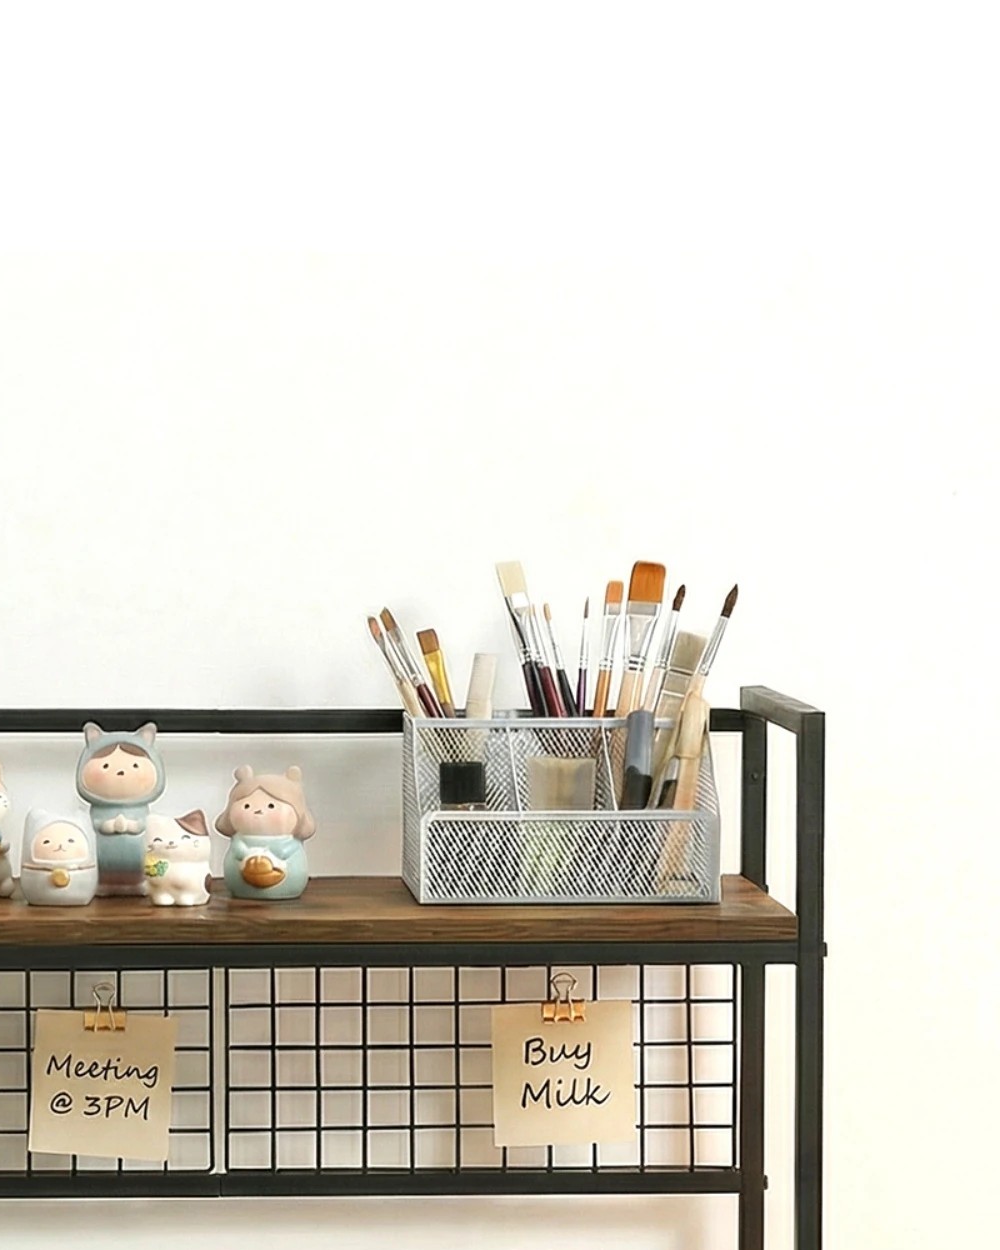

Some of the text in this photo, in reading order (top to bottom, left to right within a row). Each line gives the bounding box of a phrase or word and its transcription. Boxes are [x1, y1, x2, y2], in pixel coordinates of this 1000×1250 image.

[524, 1037, 591, 1070] Buy
[46, 1053, 159, 1089] Meeting
[50, 1091, 150, 1121] @ 3PM
[521, 1077, 611, 1109] Milk
